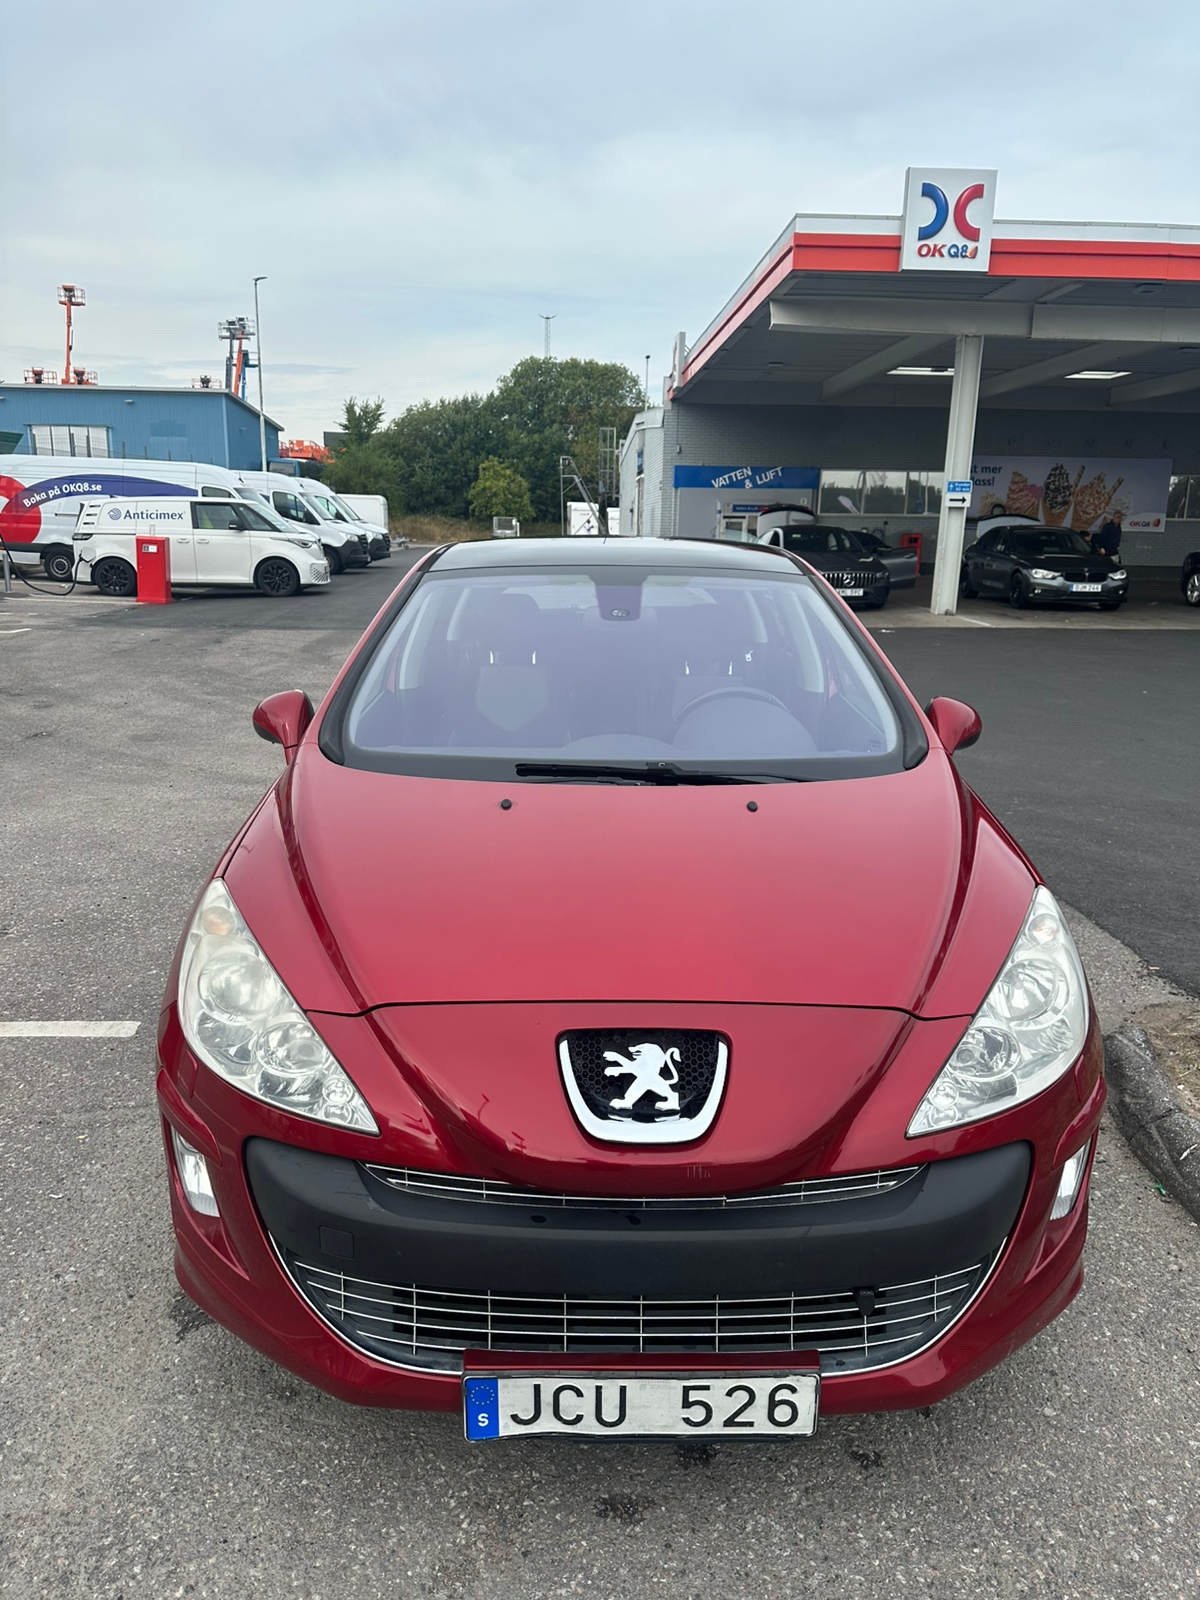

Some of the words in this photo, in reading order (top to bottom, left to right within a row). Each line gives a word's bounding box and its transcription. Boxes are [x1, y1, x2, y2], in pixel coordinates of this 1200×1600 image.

[711, 466, 752, 488] VATTEN
[744, 479, 753, 489] &
[756, 466, 783, 485] LUFT
[981, 466, 1003, 474] mer
[23, 492, 47, 508] Boka
[48, 485, 61, 499] på
[62, 482, 102, 494] OKQ8.se
[123, 509, 184, 520] Anticimex
[510, 1384, 627, 1428] JCU
[681, 1383, 799, 1428] 526
[477, 1413, 489, 1427] S
